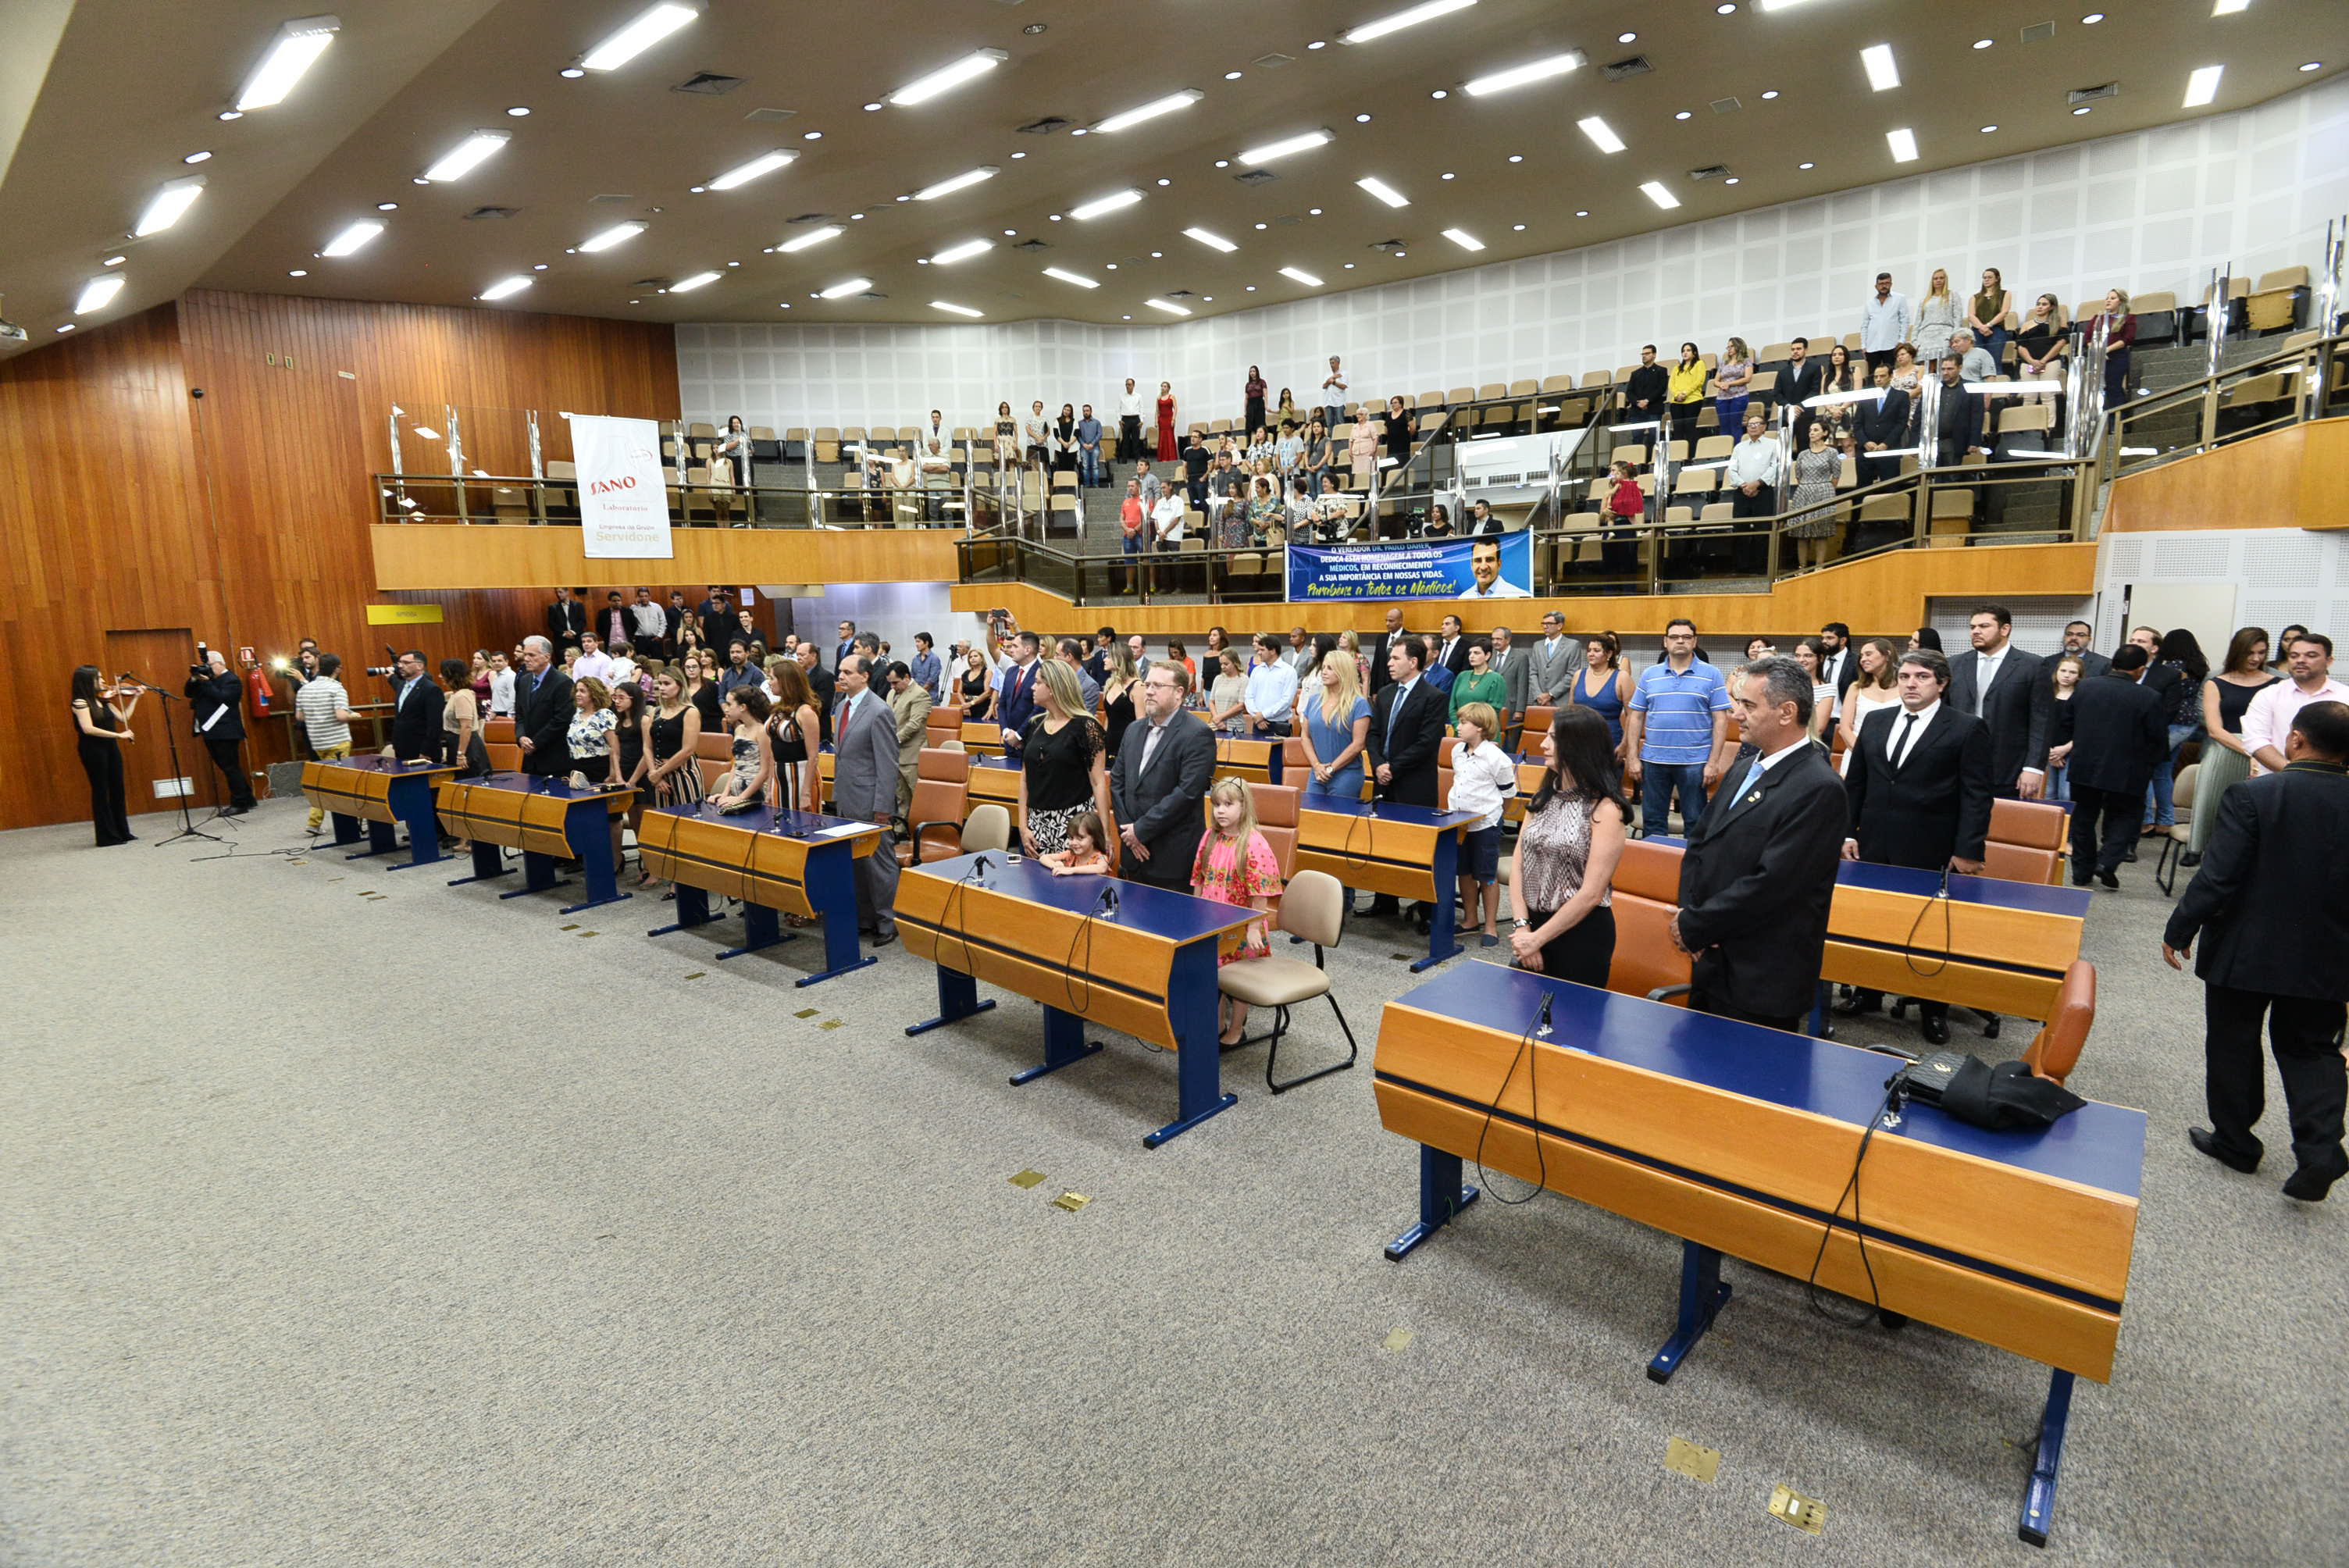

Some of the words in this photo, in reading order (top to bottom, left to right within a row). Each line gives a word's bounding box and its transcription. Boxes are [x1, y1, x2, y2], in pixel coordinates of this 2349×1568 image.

[590, 476, 636, 495] SANO
[596, 531, 660, 542] Servidone
[1329, 563, 1359, 572] MÉDICOS,
[1372, 561, 1433, 571] RECONHECIMENTO
[1338, 572, 1381, 581] IMPORTÂNCIA
[1395, 571, 1420, 579] NOSSAS
[1307, 583, 1353, 597] Parabéns
[1356, 586, 1363, 596] a
[1395, 584, 1407, 595] os
[1410, 579, 1456, 596] Médicos!
